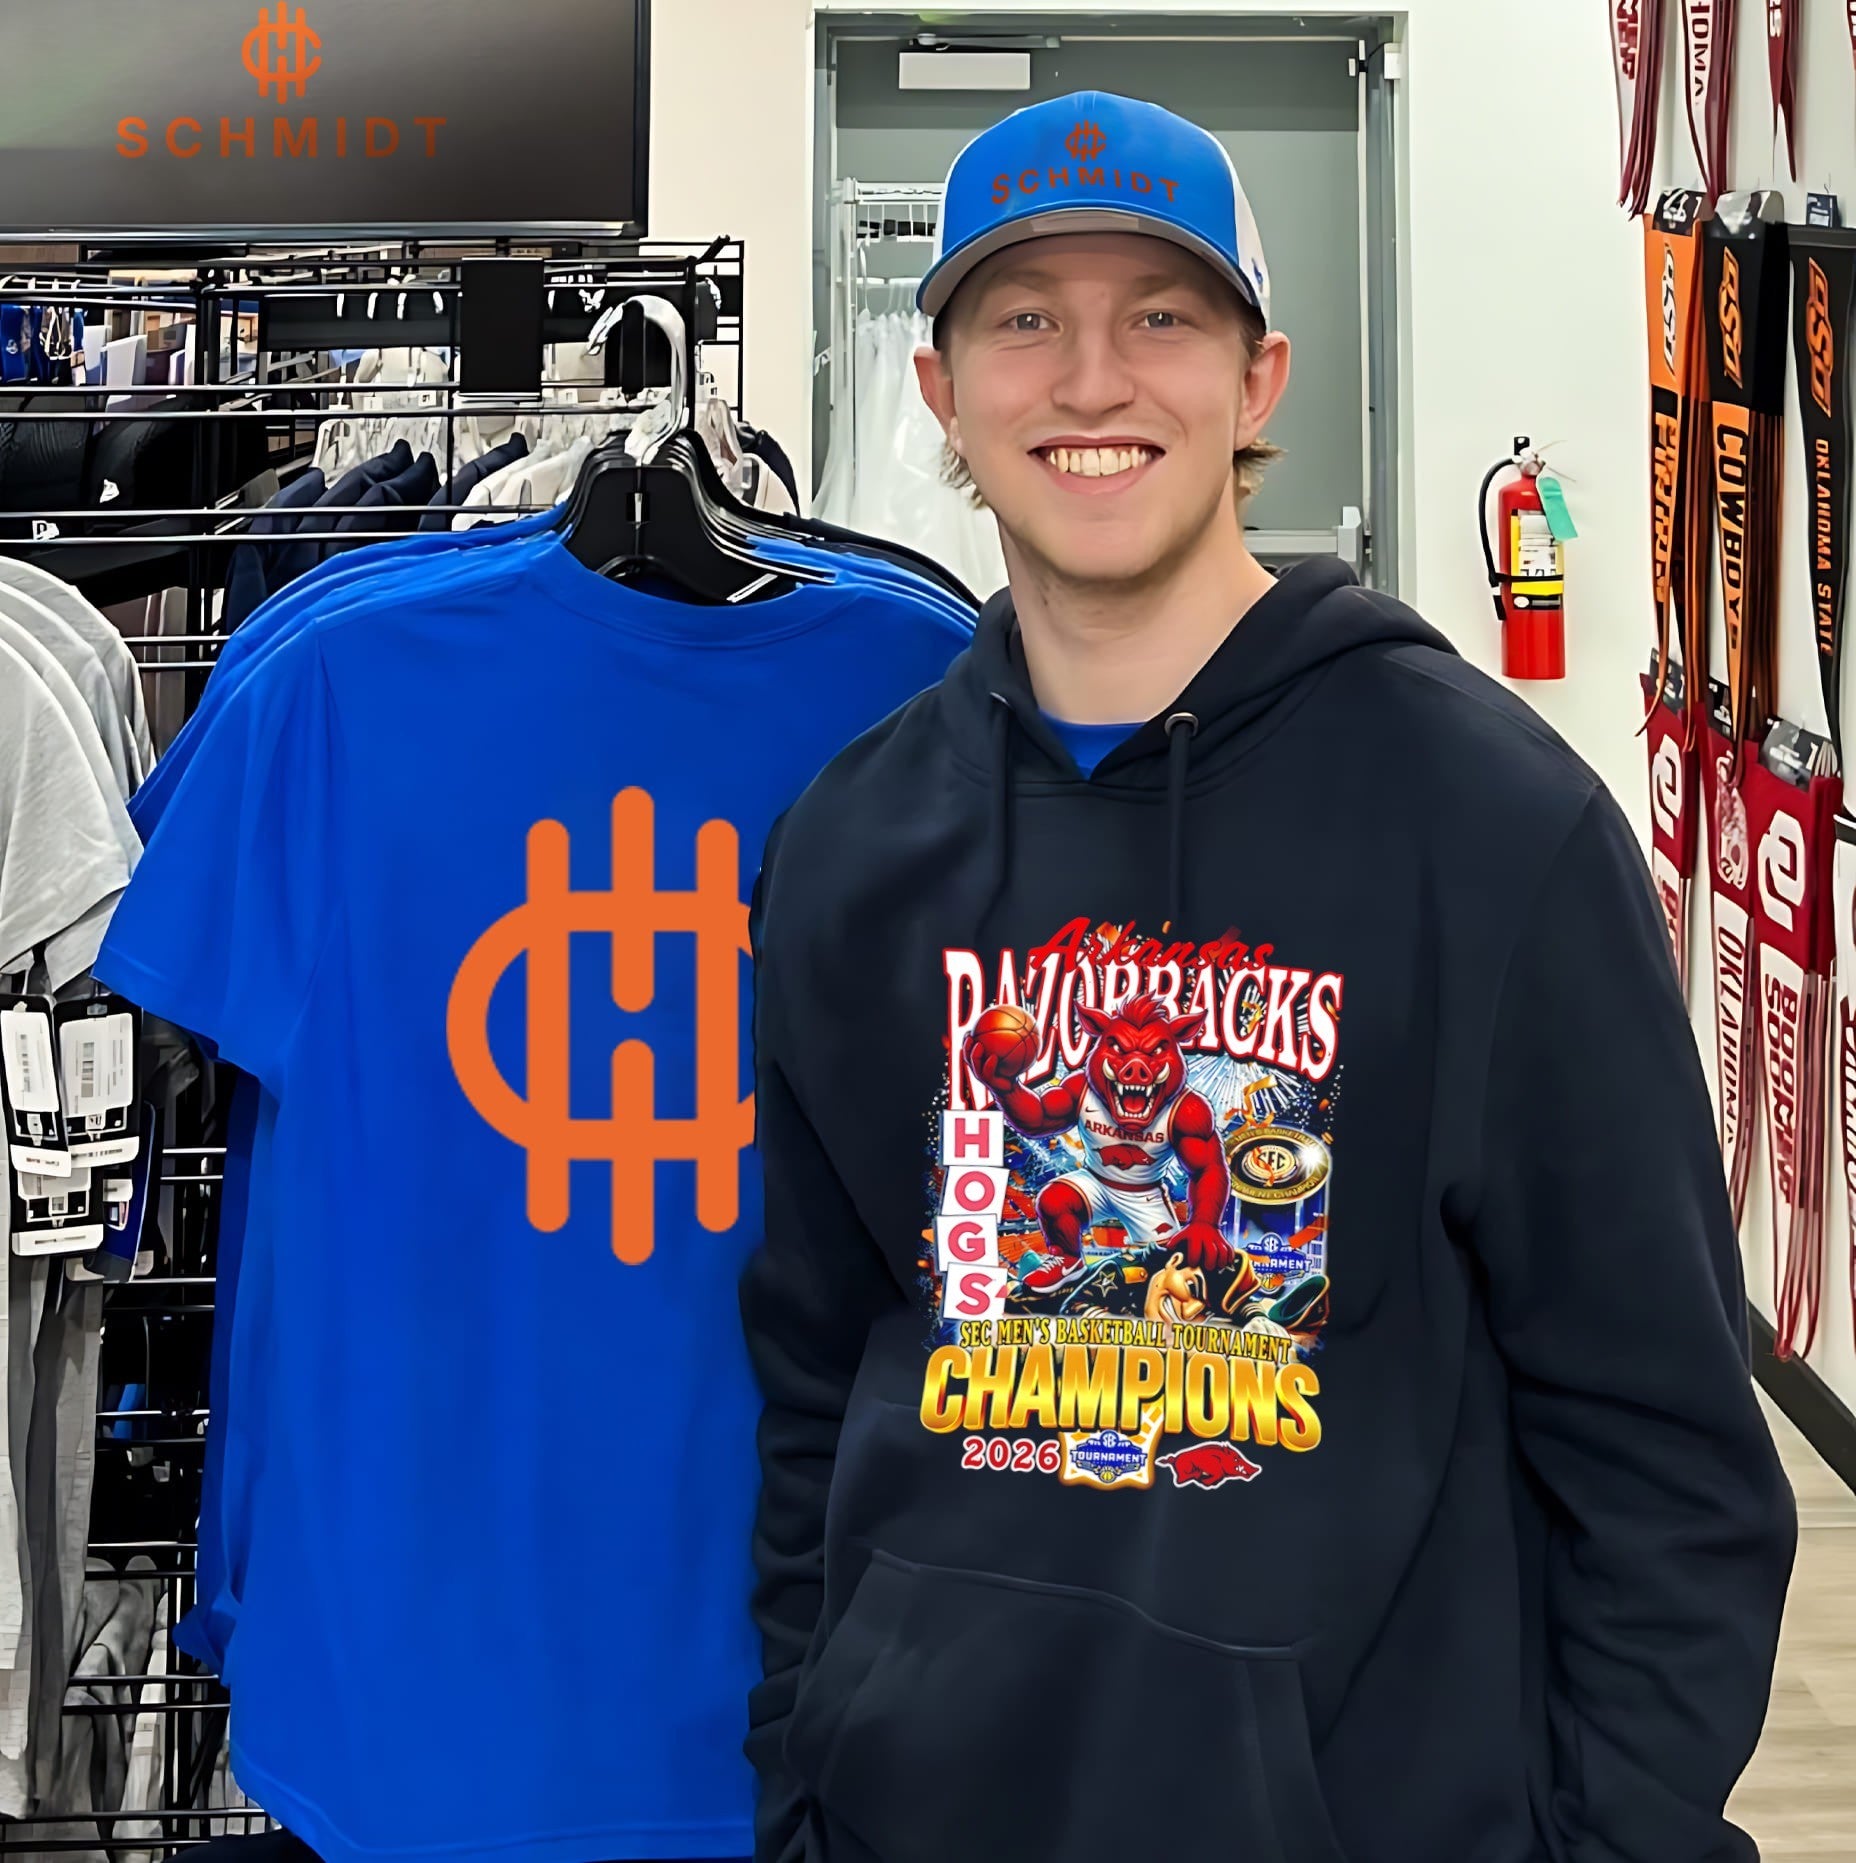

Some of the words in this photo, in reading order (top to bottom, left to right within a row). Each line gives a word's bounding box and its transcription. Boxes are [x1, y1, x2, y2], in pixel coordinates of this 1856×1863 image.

[116, 117, 446, 159] SCHMIDT
[992, 167, 1179, 204] SCHMIDT
[1816, 438, 1832, 570] OKLAHOMA
[1033, 916, 1274, 971] Arkansas
[1718, 926, 1744, 1143] OKLAHOMA
[1083, 1119, 1164, 1144] ARKANSAS
[948, 1117, 997, 1315] HOGS
[1264, 1237, 1279, 1253] SEC
[960, 1320, 991, 1348] SEC
[997, 1319, 1049, 1345] MEN'S
[1057, 1319, 1165, 1348] BASKETBALL
[1172, 1327, 1291, 1364] TOURNAMENT
[920, 1345, 1322, 1452] CHAMPIONS
[962, 1437, 1060, 1473] 2026
[1071, 1451, 1147, 1466] TOURNAMENT
[1102, 1433, 1117, 1448] SEC
